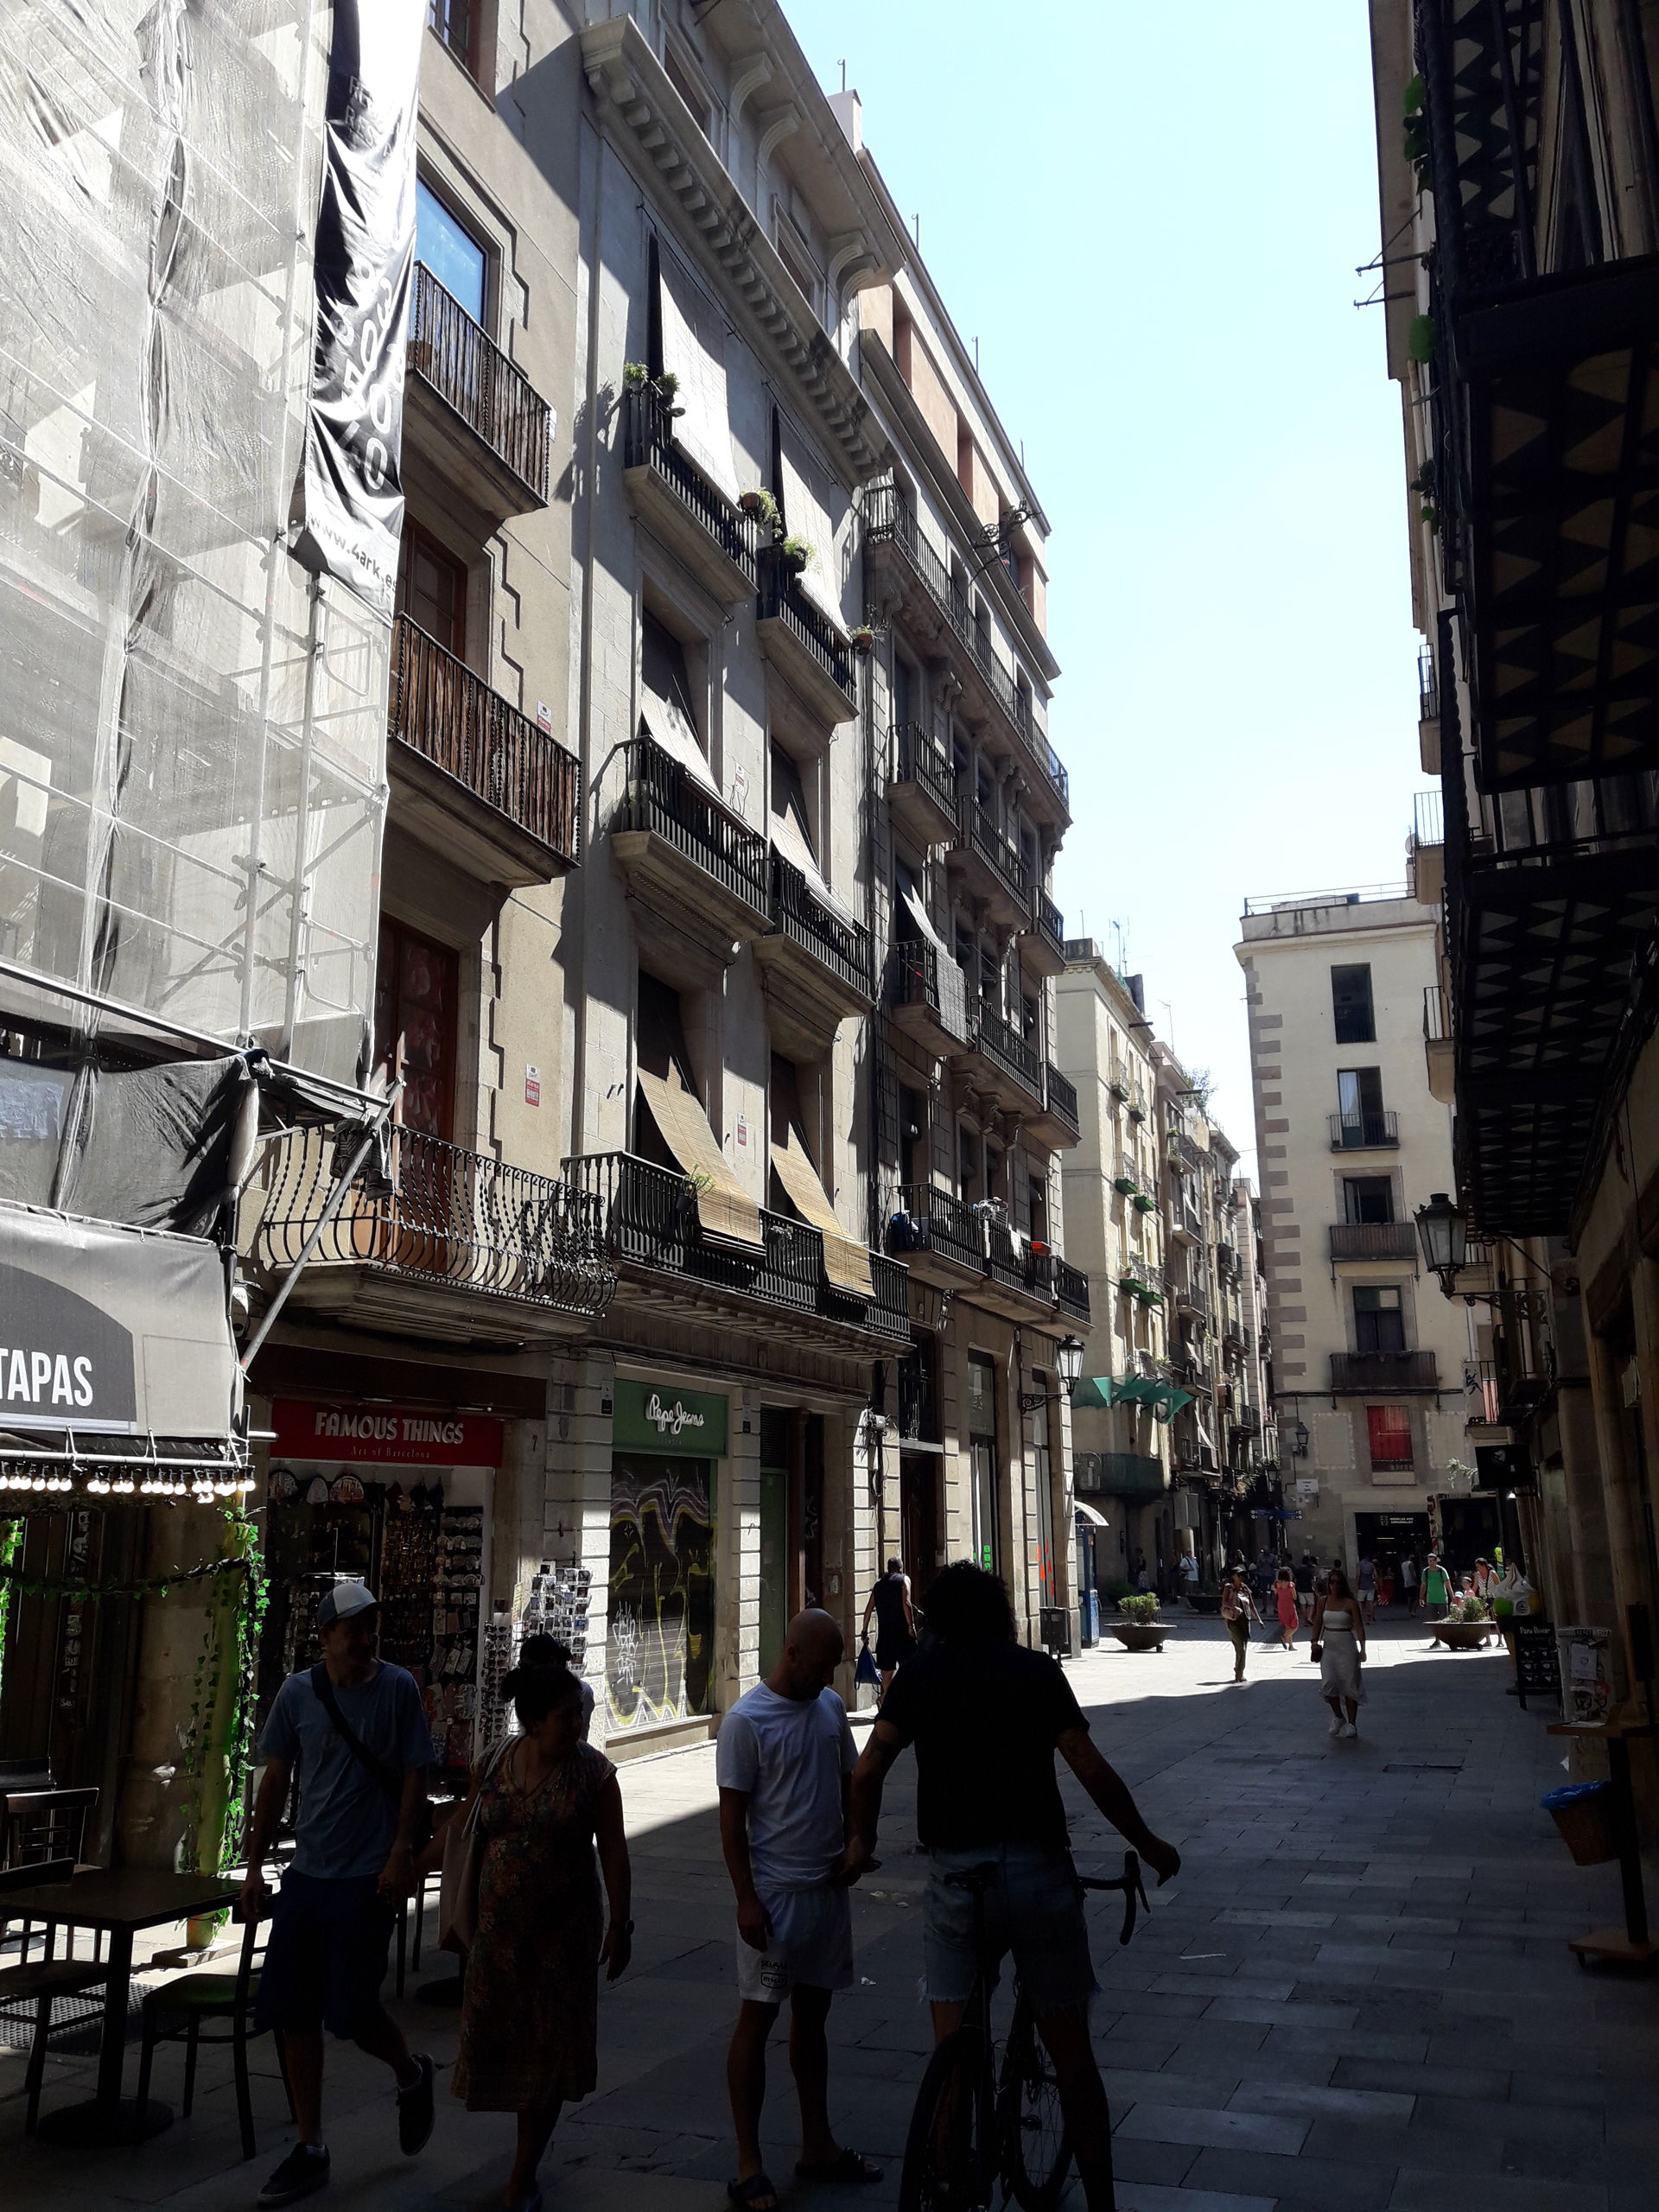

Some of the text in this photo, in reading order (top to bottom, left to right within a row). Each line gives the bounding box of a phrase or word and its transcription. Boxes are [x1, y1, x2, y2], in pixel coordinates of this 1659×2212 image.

[315, 1412, 464, 1445] FAMOUS THINGS
[645, 1394, 704, 1434] Pepe Jeans
[351, 1446, 430, 1459] Art of Barcelona
